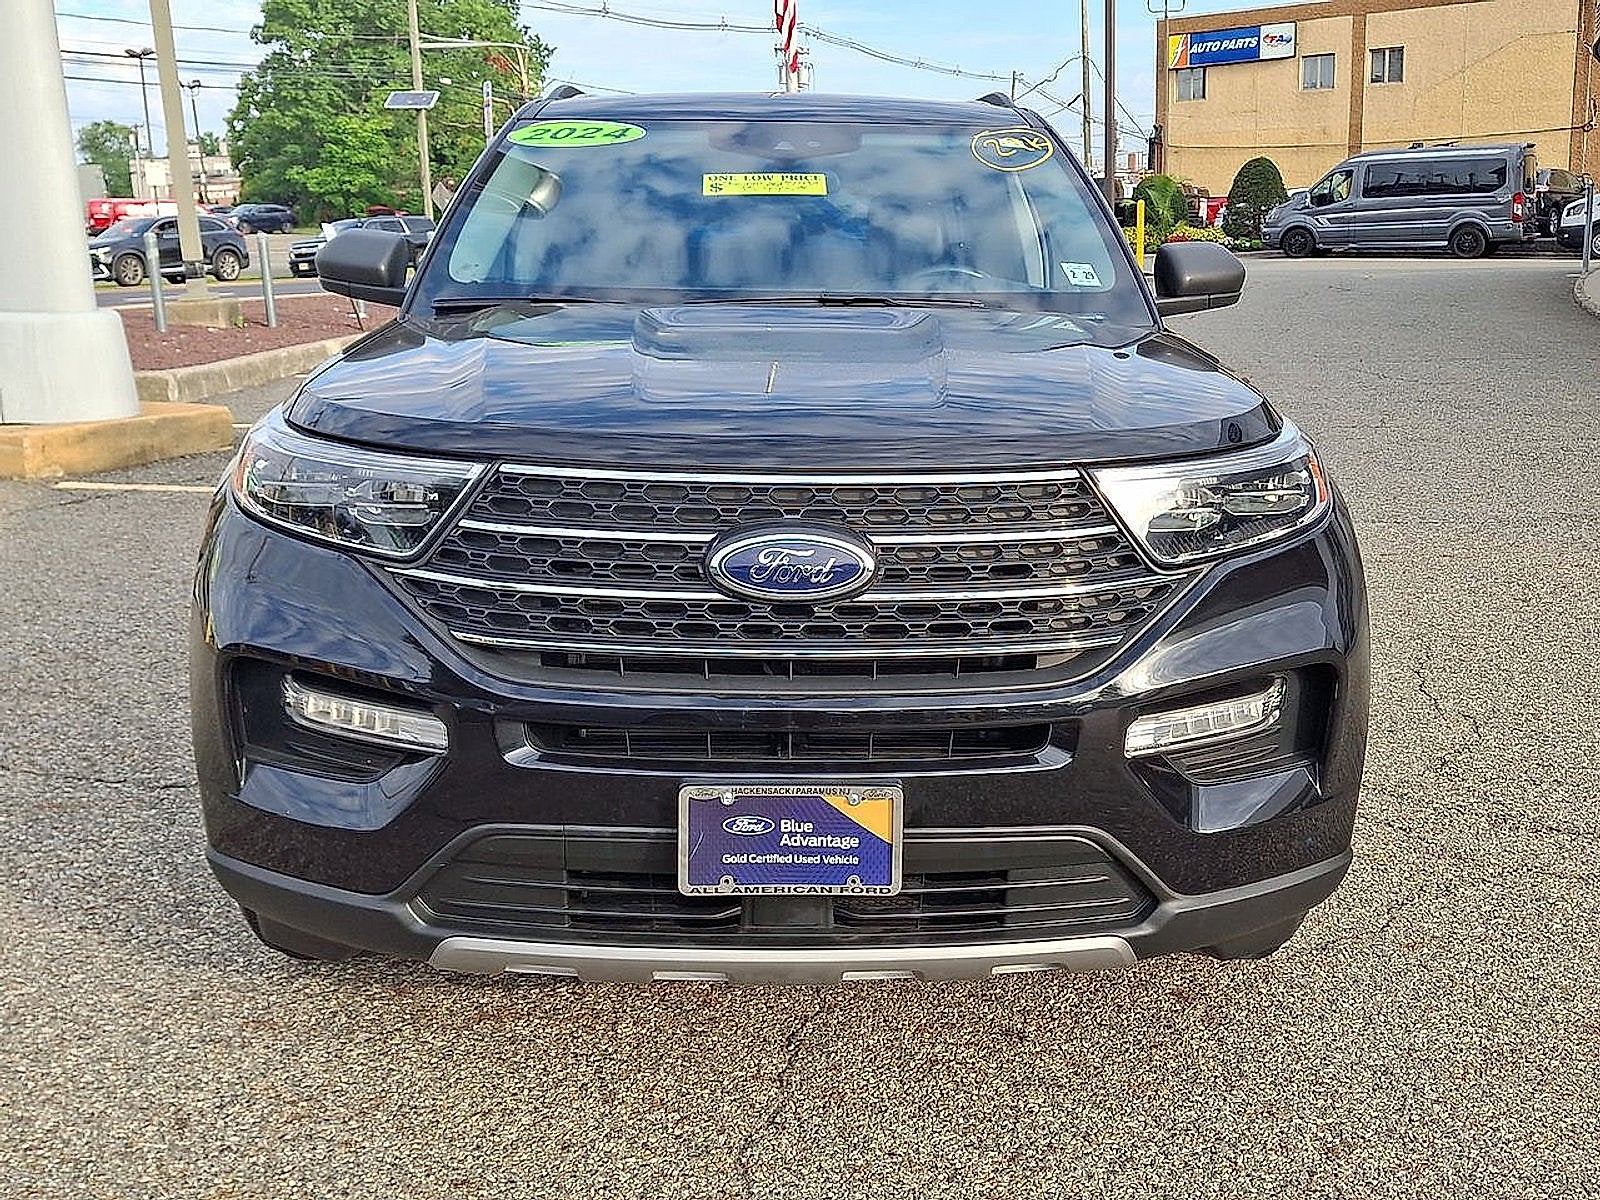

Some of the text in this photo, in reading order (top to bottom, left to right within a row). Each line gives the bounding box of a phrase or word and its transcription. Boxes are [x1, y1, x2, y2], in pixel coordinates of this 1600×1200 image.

[1190, 36, 1259, 54] AUTO PARTS
[521, 127, 632, 141] 2024
[750, 547, 836, 583] Ford
[732, 818, 766, 832] Ford
[780, 819, 814, 833] Blue
[779, 834, 860, 849] Advantage
[722, 853, 859, 865] Gold Certified Used Vehicle
[689, 885, 893, 895] ALL AMERICAN FORD
